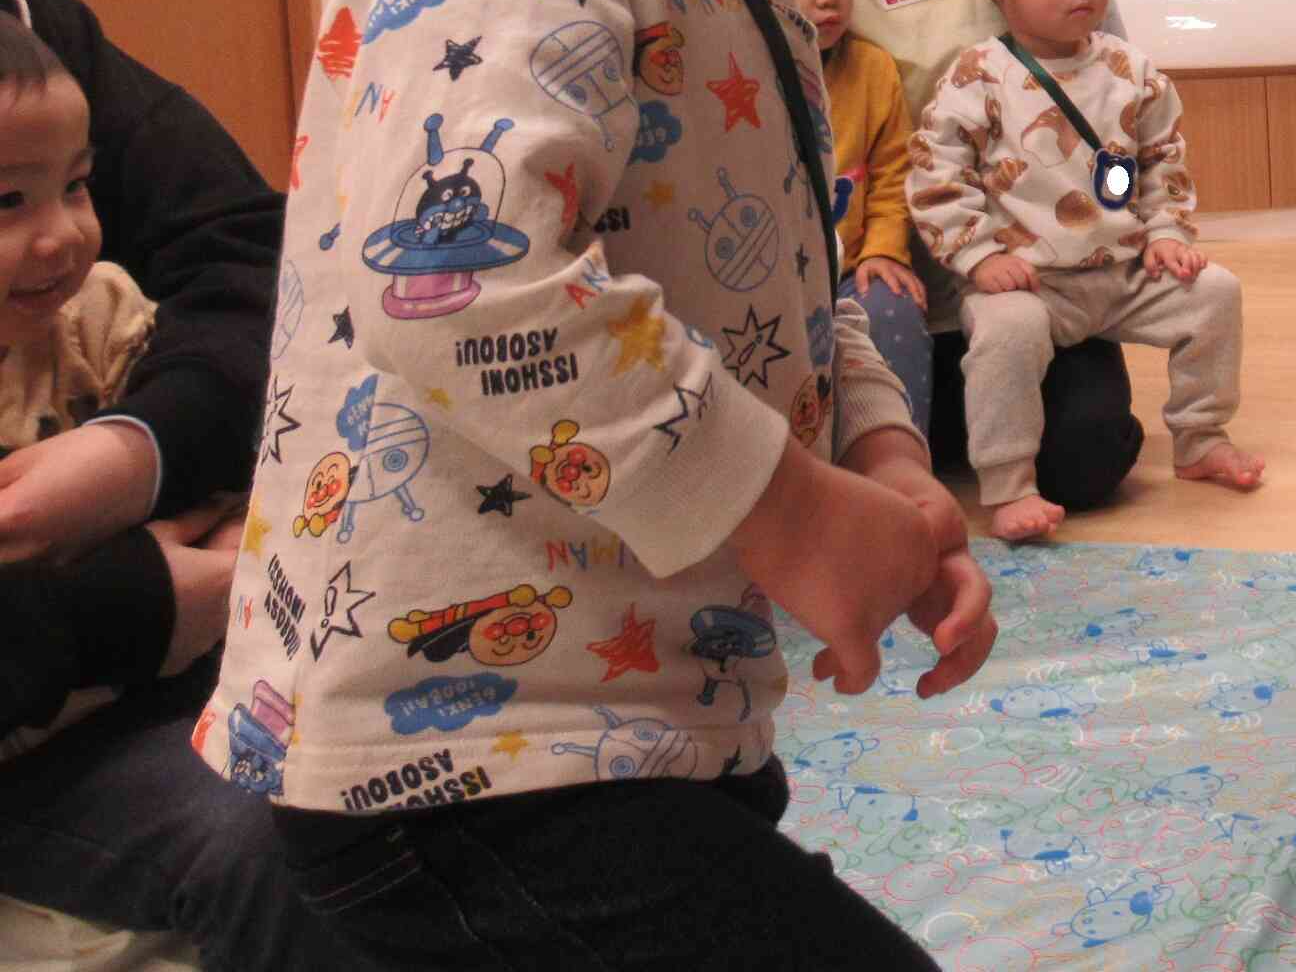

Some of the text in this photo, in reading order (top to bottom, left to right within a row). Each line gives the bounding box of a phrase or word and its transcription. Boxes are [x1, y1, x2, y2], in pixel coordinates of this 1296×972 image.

[455, 327, 558, 367] ASOBOU!
[481, 353, 579, 396] ISSHONI
[340, 747, 454, 812] ASOBOU!
